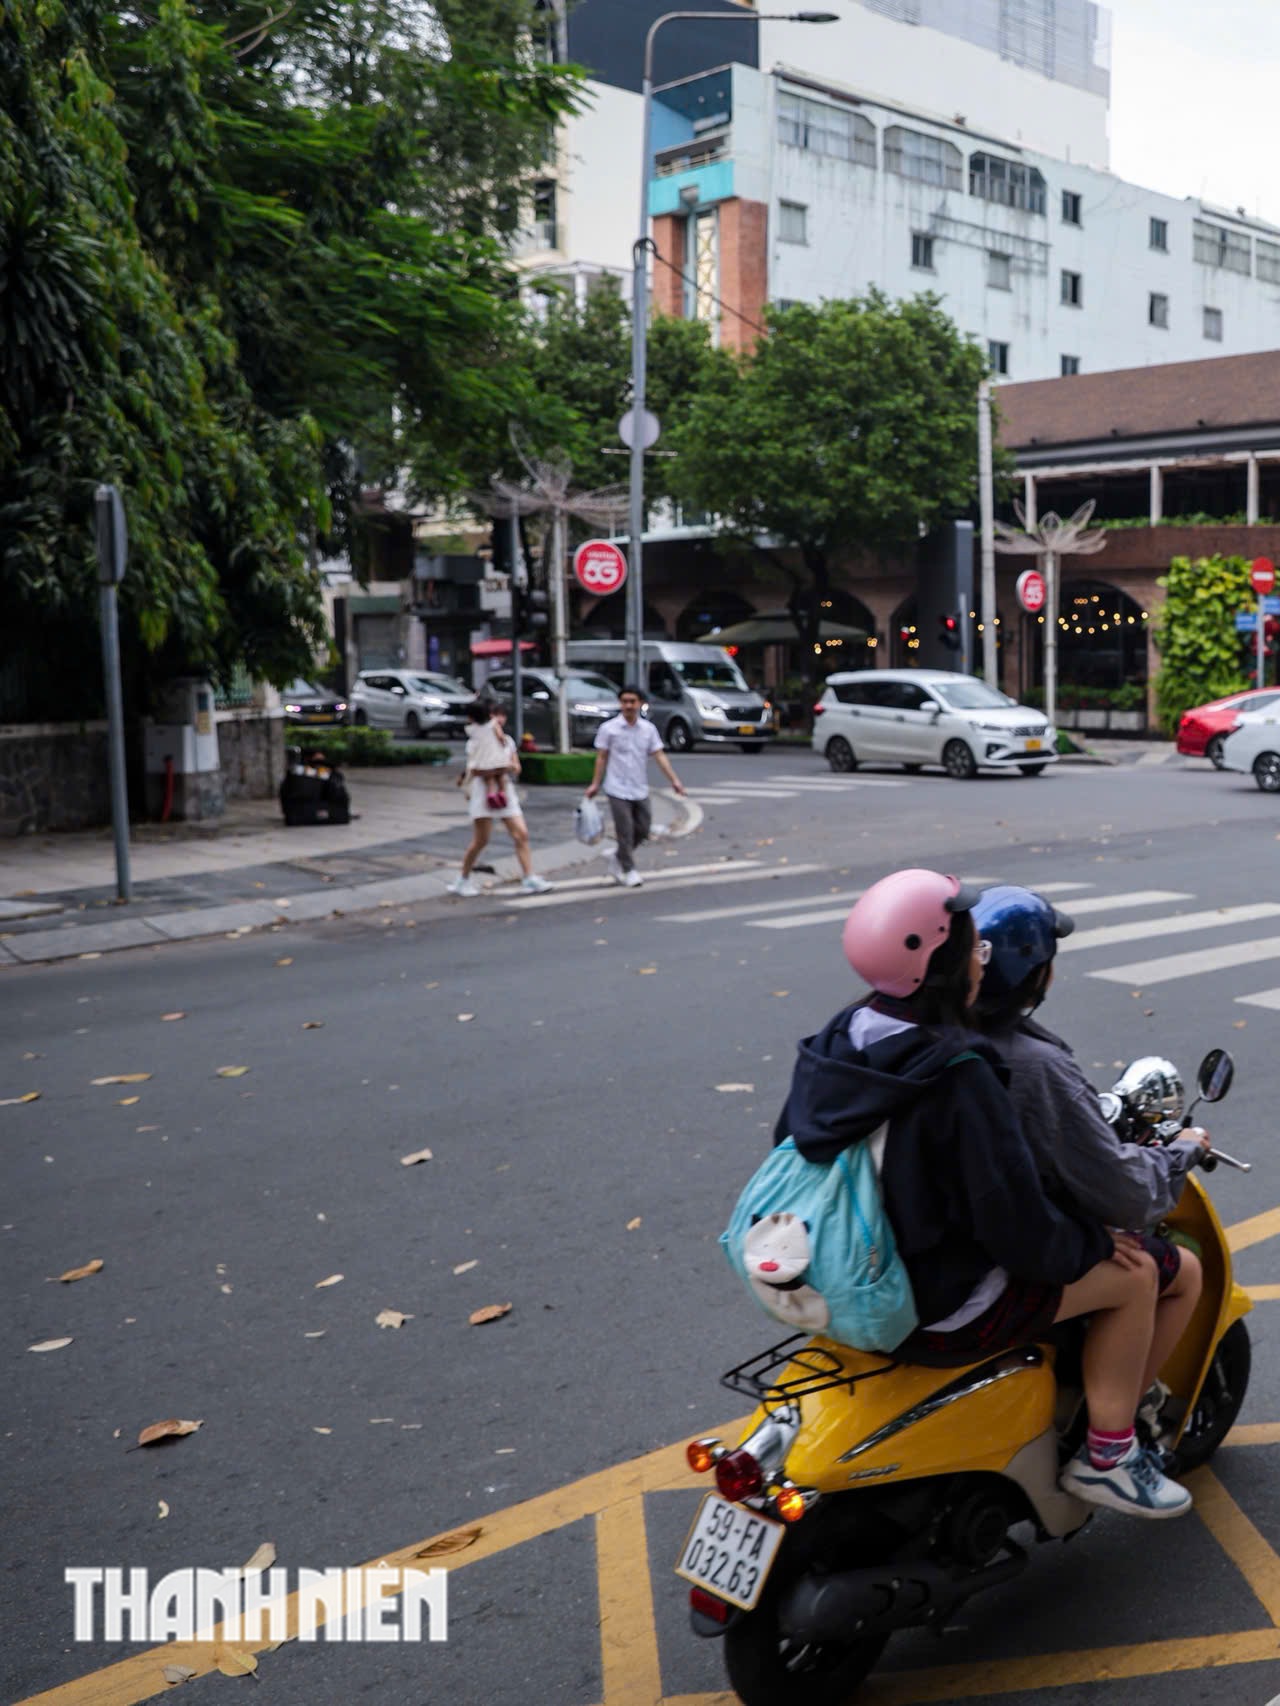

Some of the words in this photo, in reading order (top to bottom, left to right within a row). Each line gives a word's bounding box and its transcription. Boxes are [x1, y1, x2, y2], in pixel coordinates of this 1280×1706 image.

[583, 559, 618, 584] 5G
[706, 1503, 768, 1561] 59-FA
[686, 1538, 760, 1600] 032.63
